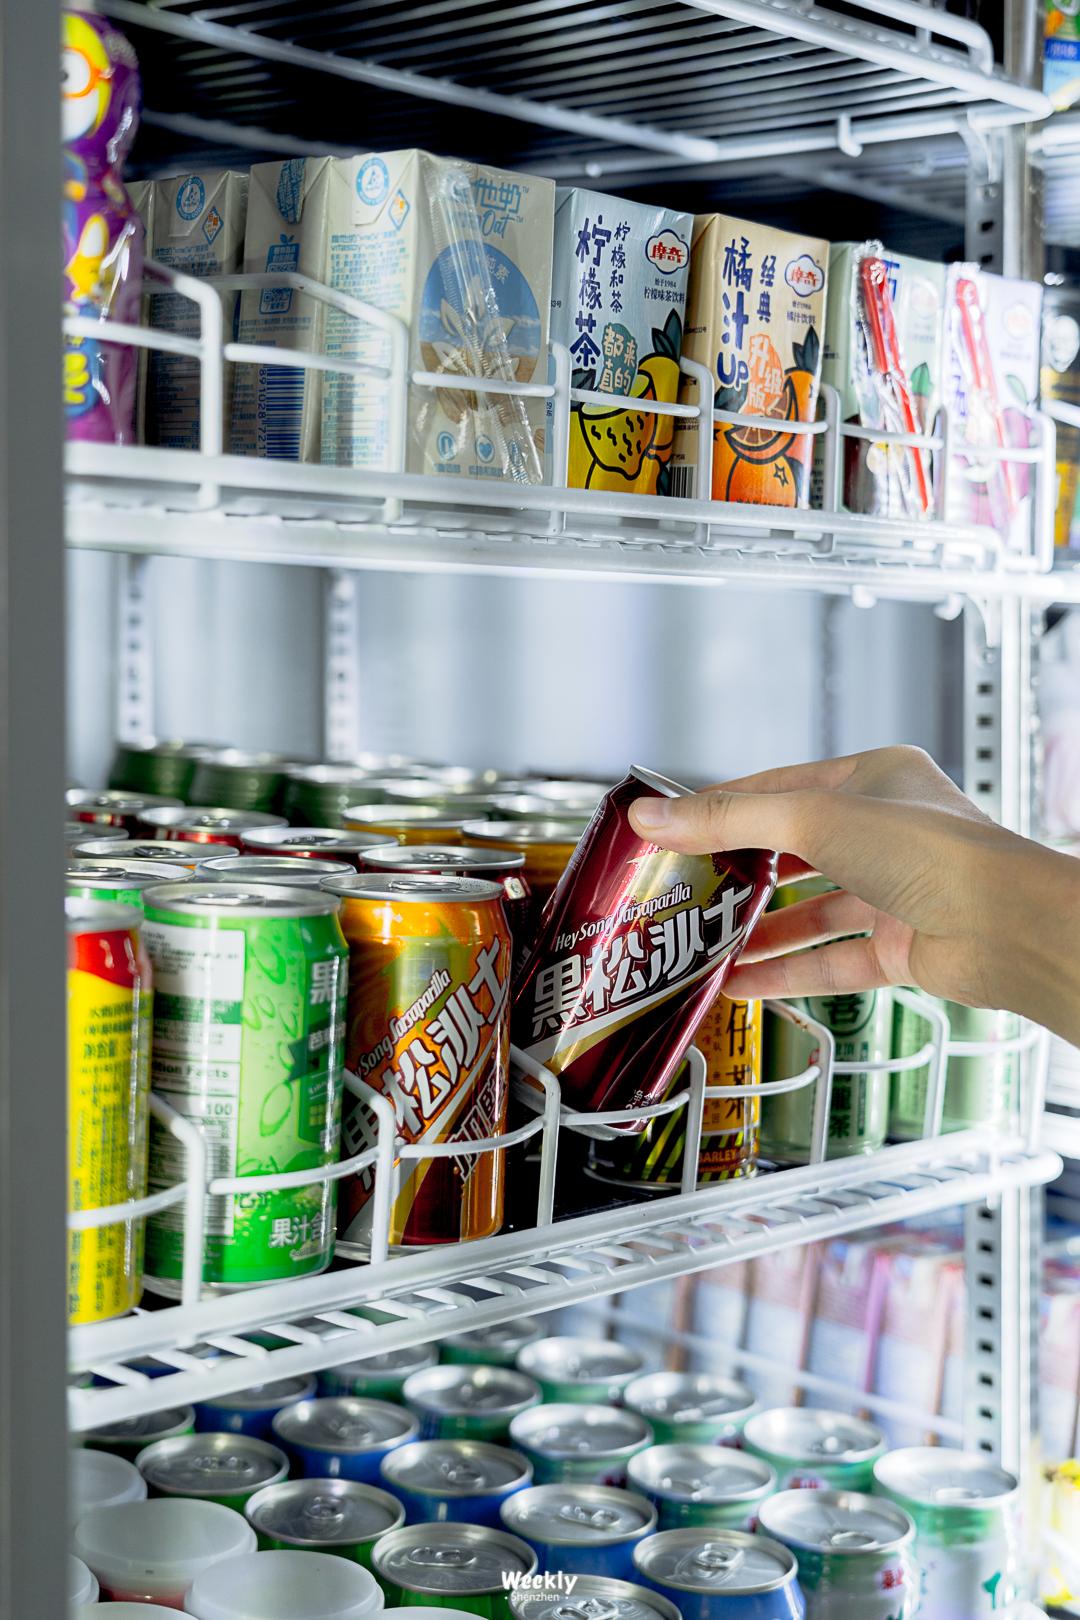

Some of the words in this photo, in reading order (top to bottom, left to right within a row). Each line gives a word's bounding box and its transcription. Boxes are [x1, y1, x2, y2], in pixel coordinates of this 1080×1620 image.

[570, 215, 611, 367] 柠檬茶
[610, 221, 631, 314] 柠檬和茶
[650, 241, 684, 263] 摩奇
[722, 236, 753, 350] 橘汁
[757, 255, 777, 323] 经典
[531, 884, 754, 1038] 黑松沙士
[555, 929, 579, 952] Hey
[578, 913, 616, 942] Song
[616, 882, 692, 926] Sarsaparilla
